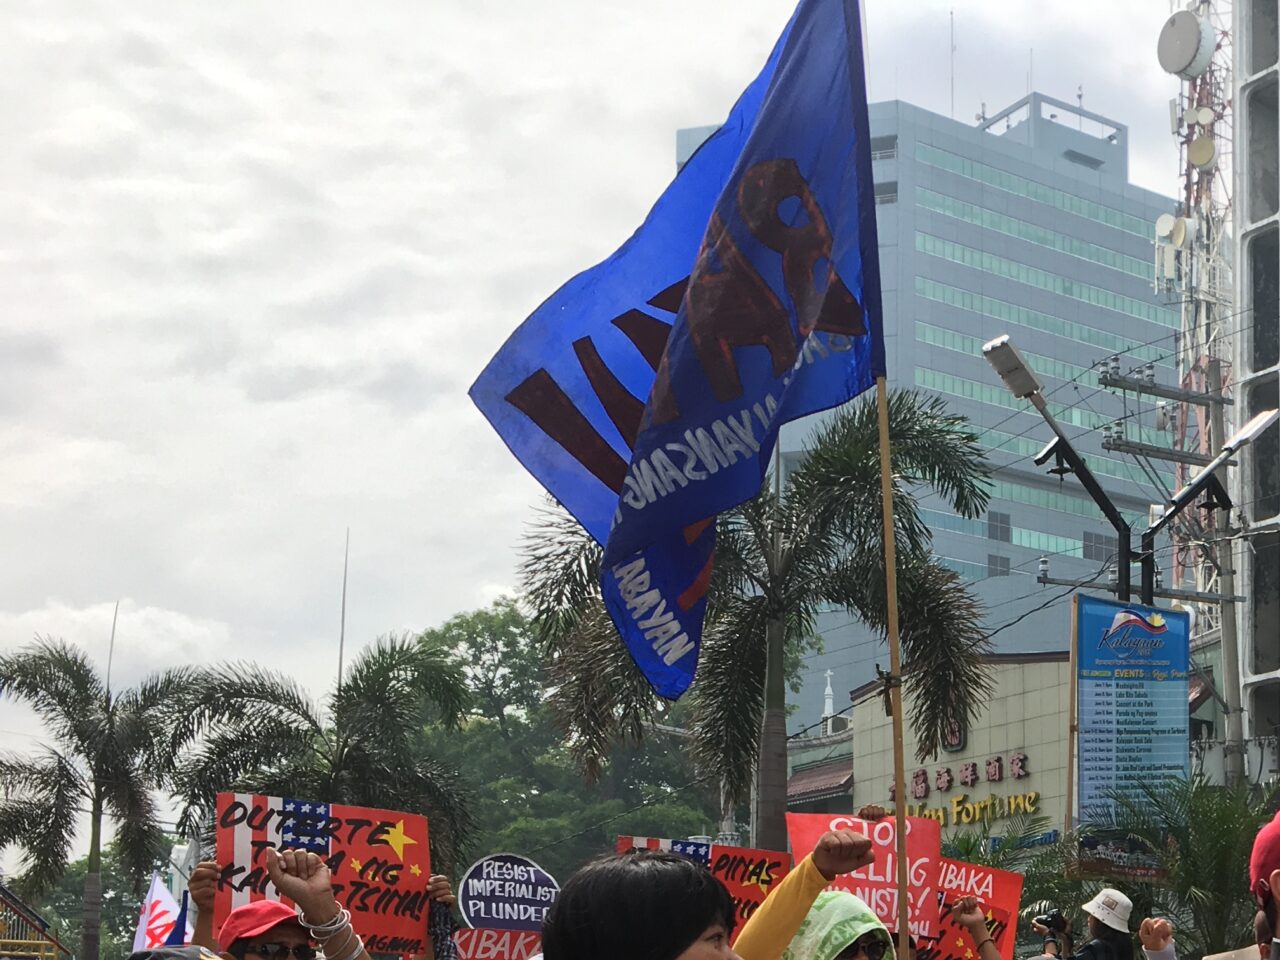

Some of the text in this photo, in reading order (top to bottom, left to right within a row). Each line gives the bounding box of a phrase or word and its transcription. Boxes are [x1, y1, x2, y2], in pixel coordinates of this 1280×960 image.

[482, 859, 538, 883] RESIST
[712, 854, 782, 885] PINAS
[939, 861, 993, 899] IBAKA
[468, 878, 560, 903] IMPERIALIST
